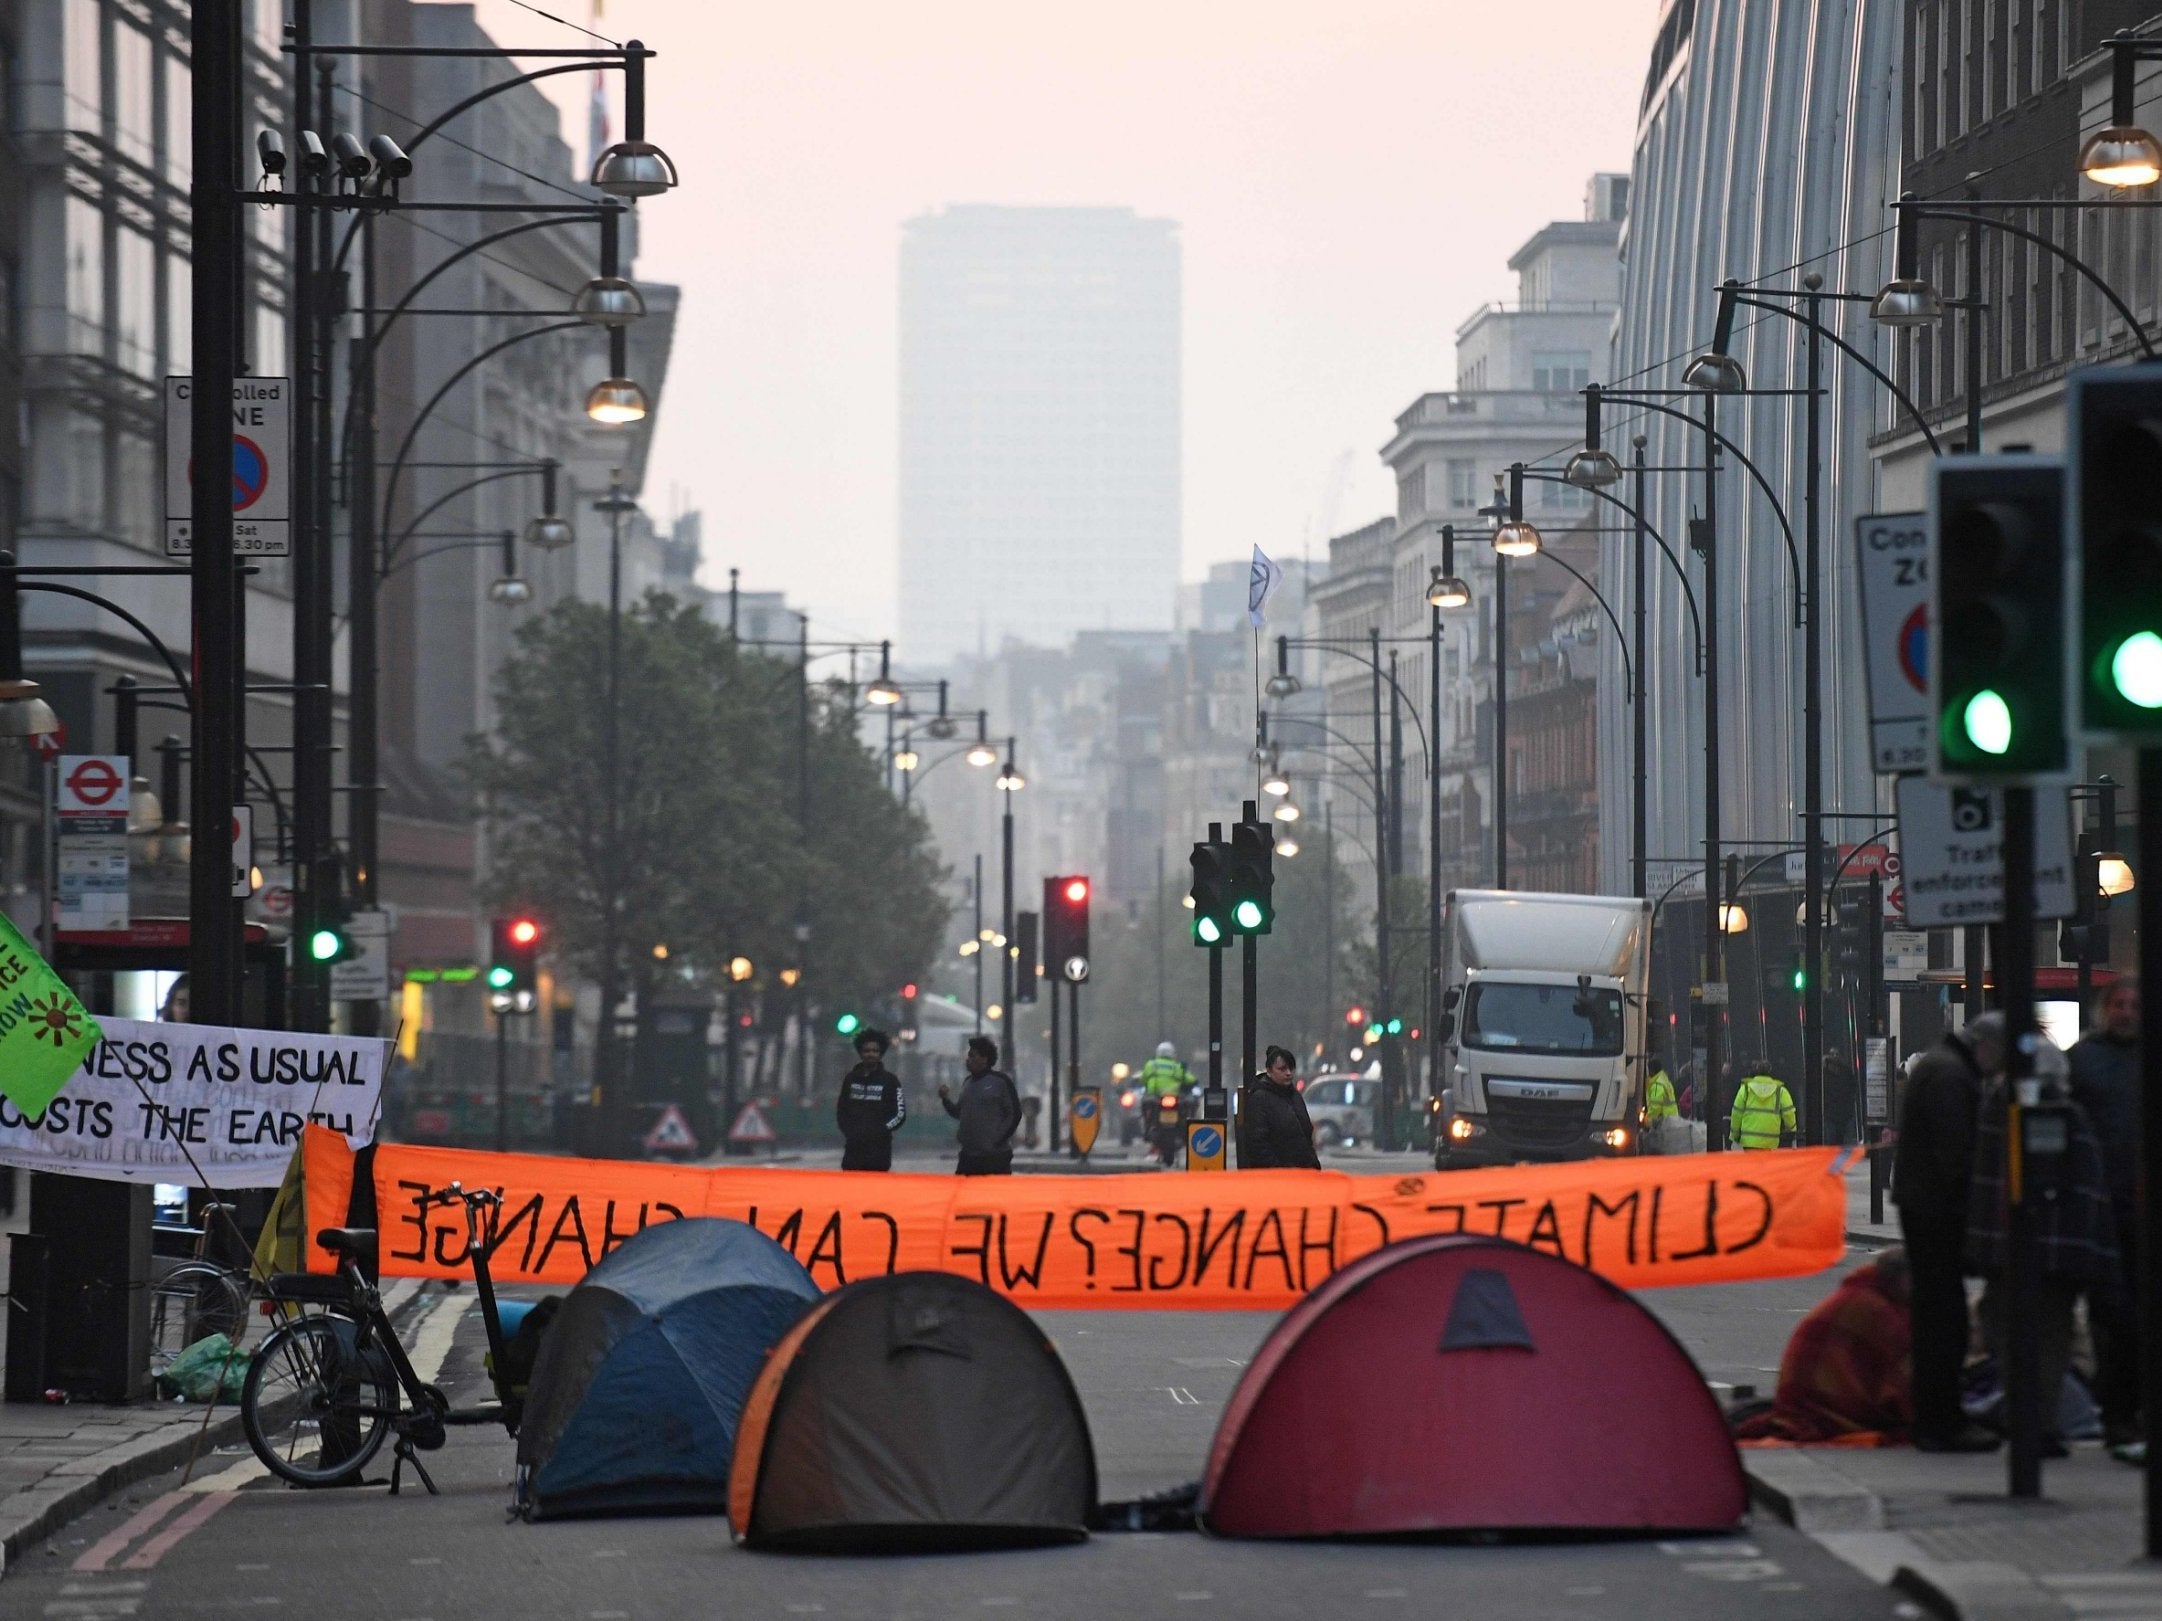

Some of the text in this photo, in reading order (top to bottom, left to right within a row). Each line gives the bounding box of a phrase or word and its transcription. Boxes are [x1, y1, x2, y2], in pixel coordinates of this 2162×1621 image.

[176, 384, 280, 400] Colled
[235, 525, 258, 536] Sat
[265, 541, 285, 552] pm
[187, 1043, 239, 1083] AS
[250, 1046, 366, 1085] USUAL
[139, 1103, 211, 1144] THE
